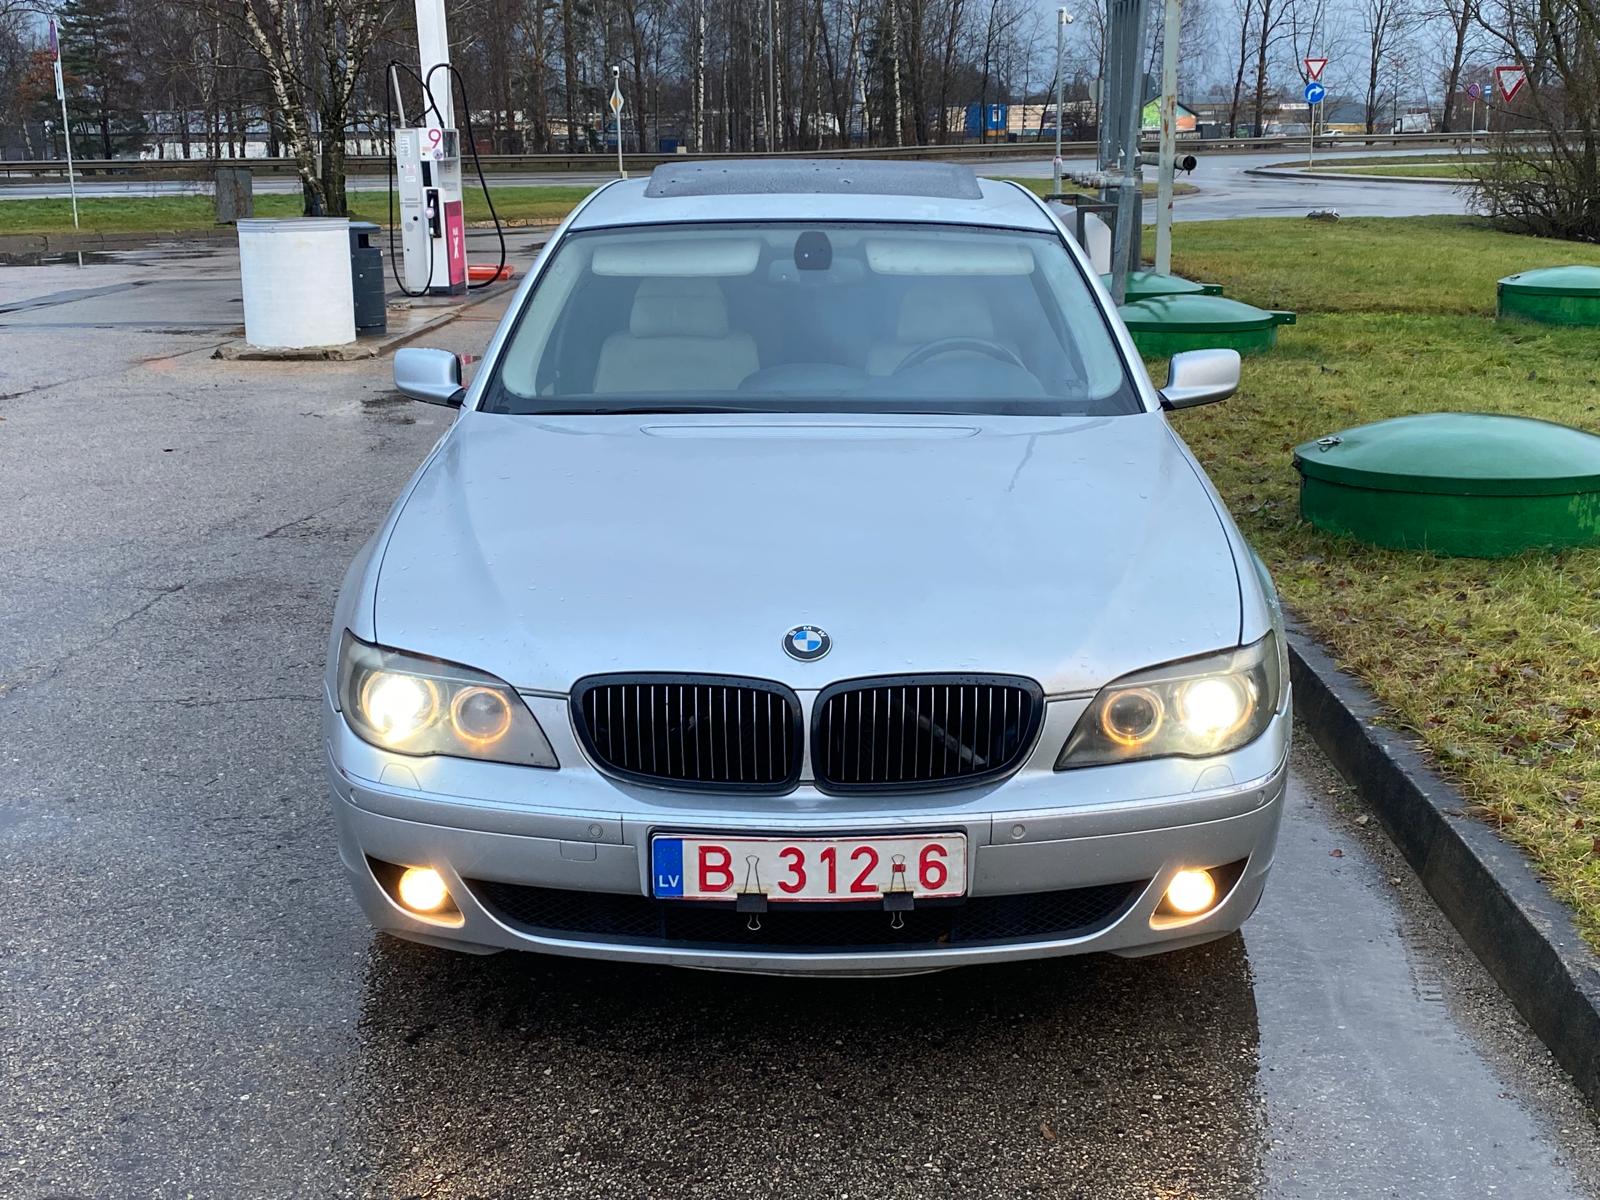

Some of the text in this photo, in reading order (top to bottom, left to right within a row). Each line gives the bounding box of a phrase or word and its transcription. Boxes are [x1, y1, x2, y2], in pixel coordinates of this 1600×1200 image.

[428, 129, 441, 149] 9
[788, 626, 827, 637] BMW
[698, 845, 735, 893] B
[658, 875, 680, 888] LV
